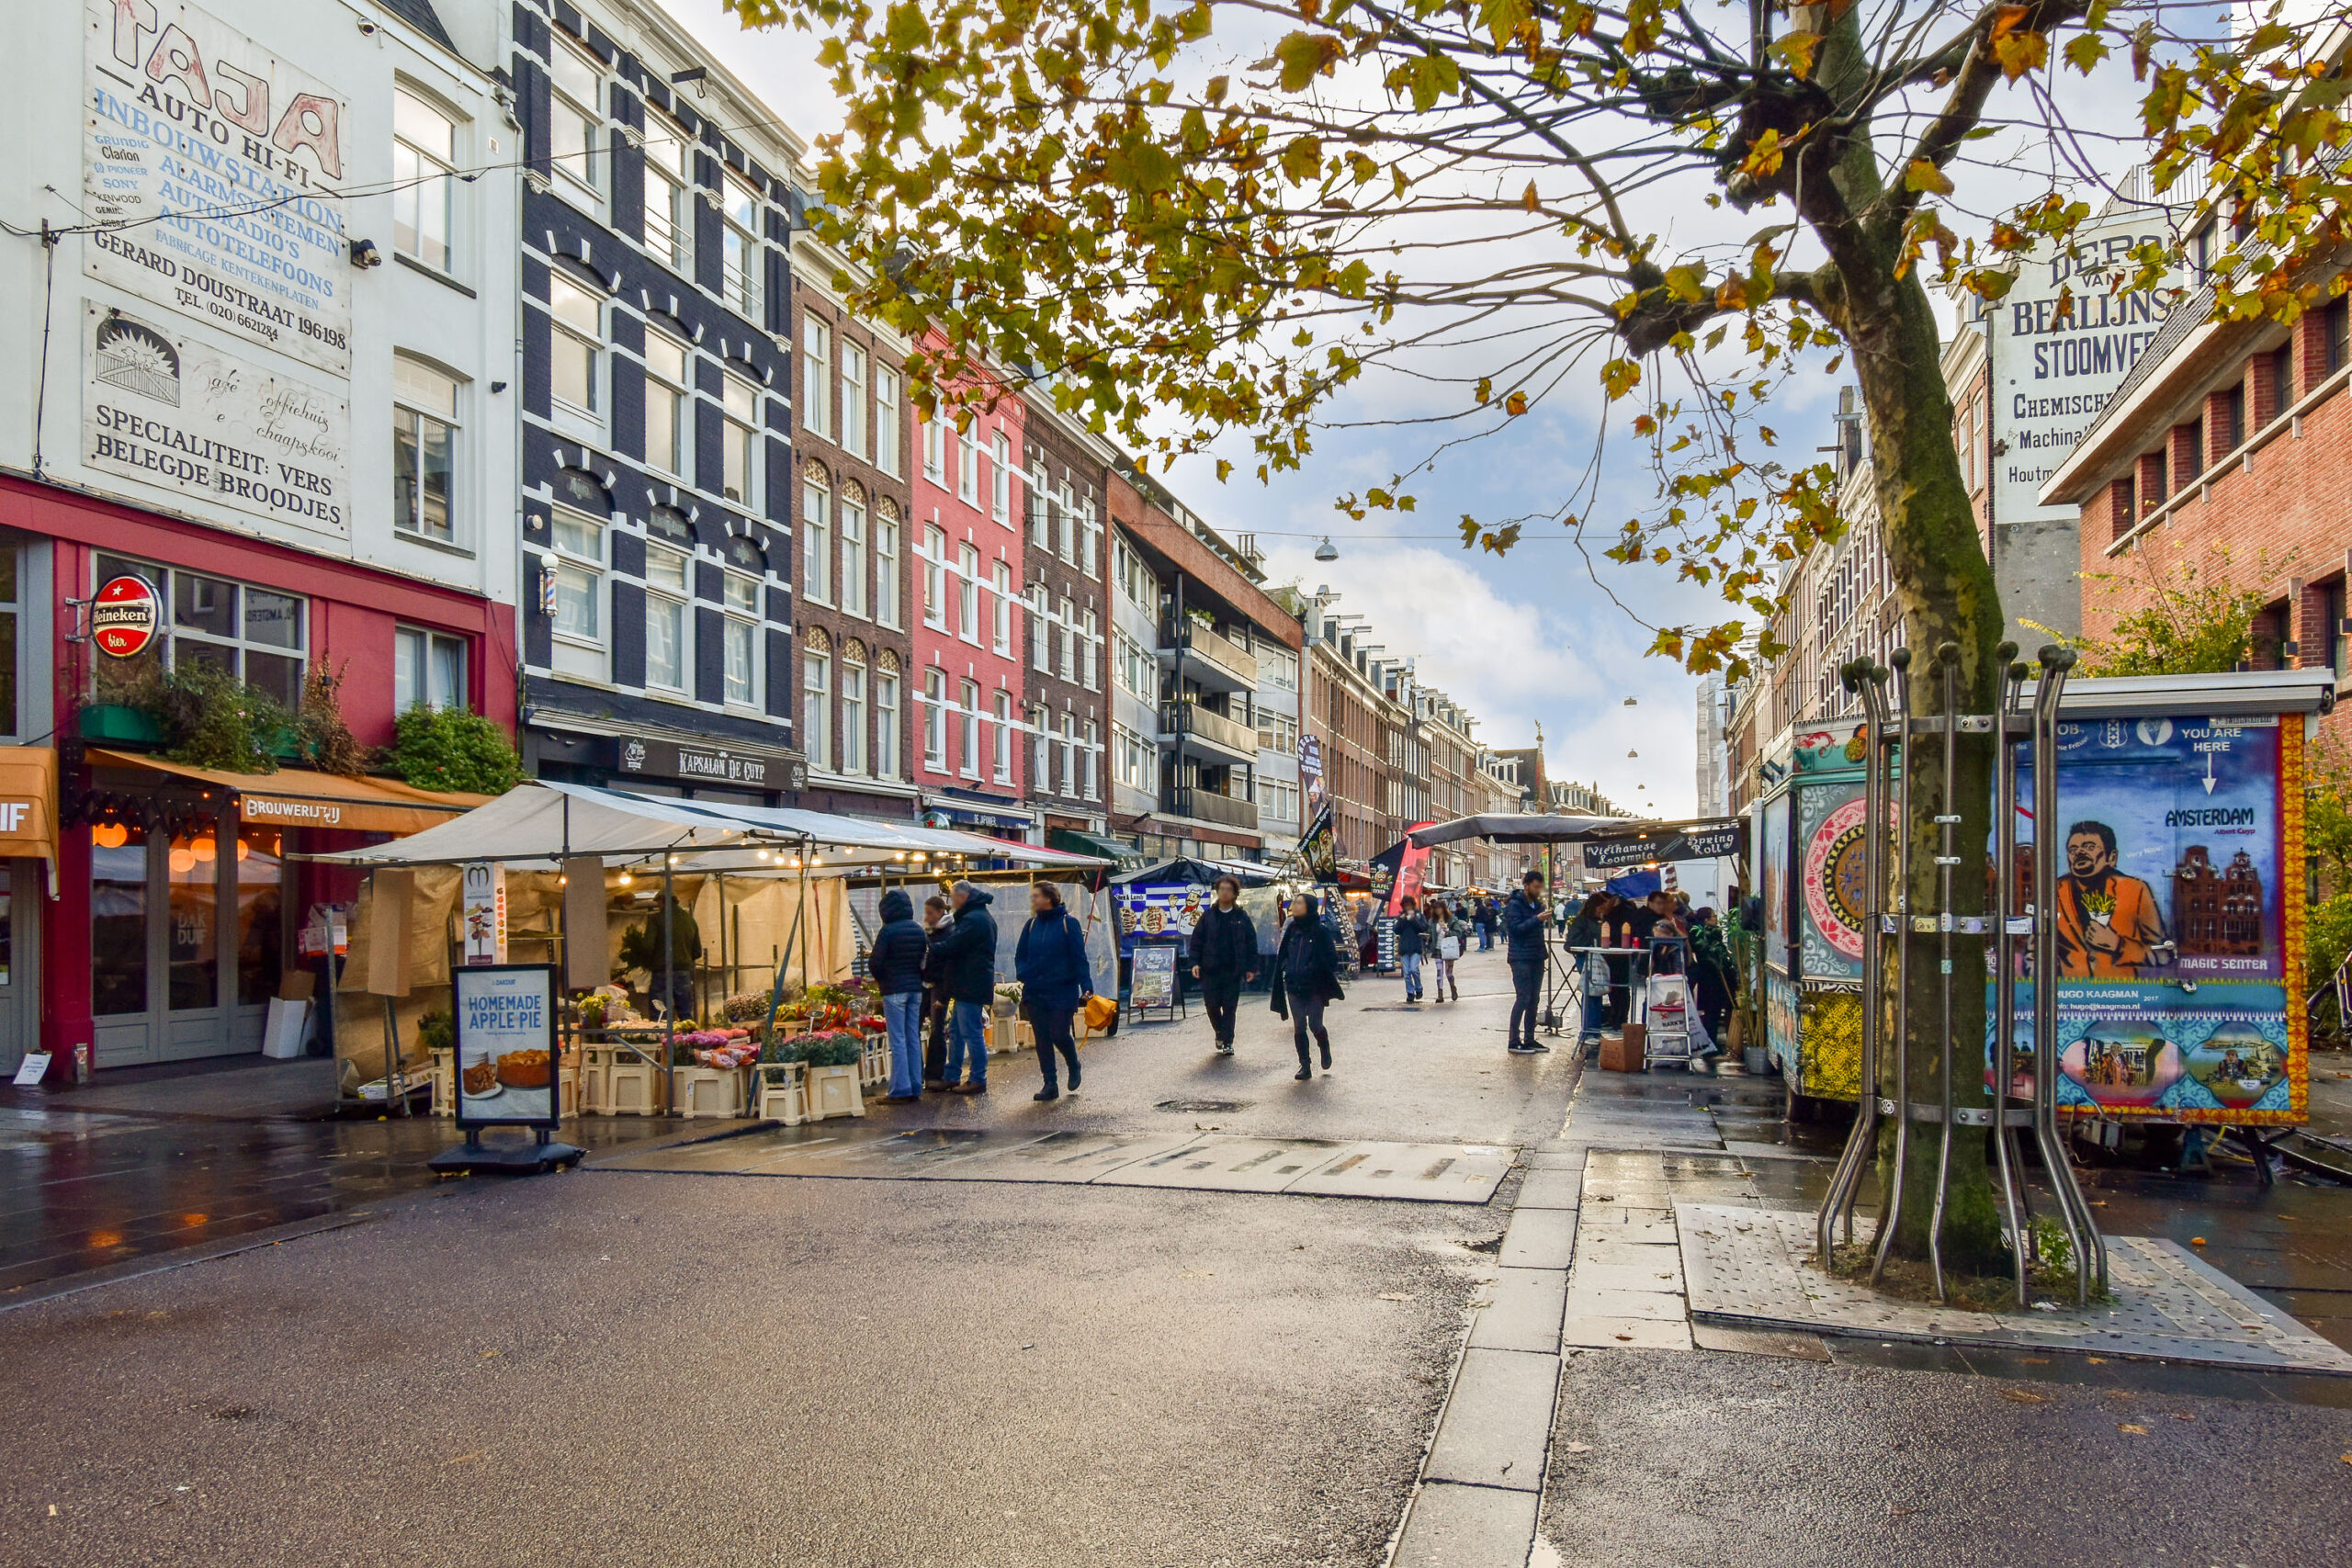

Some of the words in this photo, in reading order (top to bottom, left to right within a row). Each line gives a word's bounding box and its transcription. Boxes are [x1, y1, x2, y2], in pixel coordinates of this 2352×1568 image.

[109, 0, 342, 180] TAJA
[95, 135, 149, 149] GRUNDIG
[137, 83, 229, 144] AUTO
[242, 135, 311, 188] HI-FI
[94, 87, 343, 232] INBOUWSTATION
[102, 146, 140, 162] Clarion
[107, 164, 148, 175] PIONEER
[103, 178, 138, 189] SONY
[97, 194, 141, 203] KENWOOD
[159, 155, 339, 257] ALARMSYSTEMEN
[158, 180, 300, 259] AUTORADIO'S
[159, 205, 333, 297] AUTOTELEFOONS
[95, 230, 176, 276] GERARD
[182, 266, 294, 328] DOUSTRAAT
[155, 230, 217, 266] FABRICAGE
[221, 258, 319, 310] KENTEKENPLATEN
[175, 288, 204, 310] TEL.
[207, 301, 236, 321] (020)
[2020, 426, 2087, 449] Machina
[96, 404, 268, 475] SPECIALITEIT:
[277, 463, 332, 495] VERS
[96, 434, 209, 486] BELEGDE
[94, 608, 148, 624] Heineken
[108, 633, 127, 647] bier
[2182, 728, 2210, 739] YOU
[2214, 728, 2242, 738] ARE
[2194, 741, 2231, 752] HERE
[679, 752, 725, 775] KAPSALON
[729, 761, 741, 777] DE
[743, 763, 764, 781] CUYP
[246, 799, 319, 818] BROUWERIJ
[2165, 807, 2254, 827] AMSTERDAM
[1687, 834, 1734, 850] Spring
[1599, 852, 1654, 865] Loempia
[1690, 844, 1722, 855] Roll
[2180, 959, 2218, 970] MAGIC
[2222, 959, 2267, 971] SENTER
[469, 995, 541, 1011] HOMEMADE
[2086, 990, 2139, 999] KAAGMAN
[2070, 1003, 2141, 1011] hugo@kaagman.nl
[469, 1011, 515, 1030] APPLE
[519, 1011, 541, 1029] PIE
